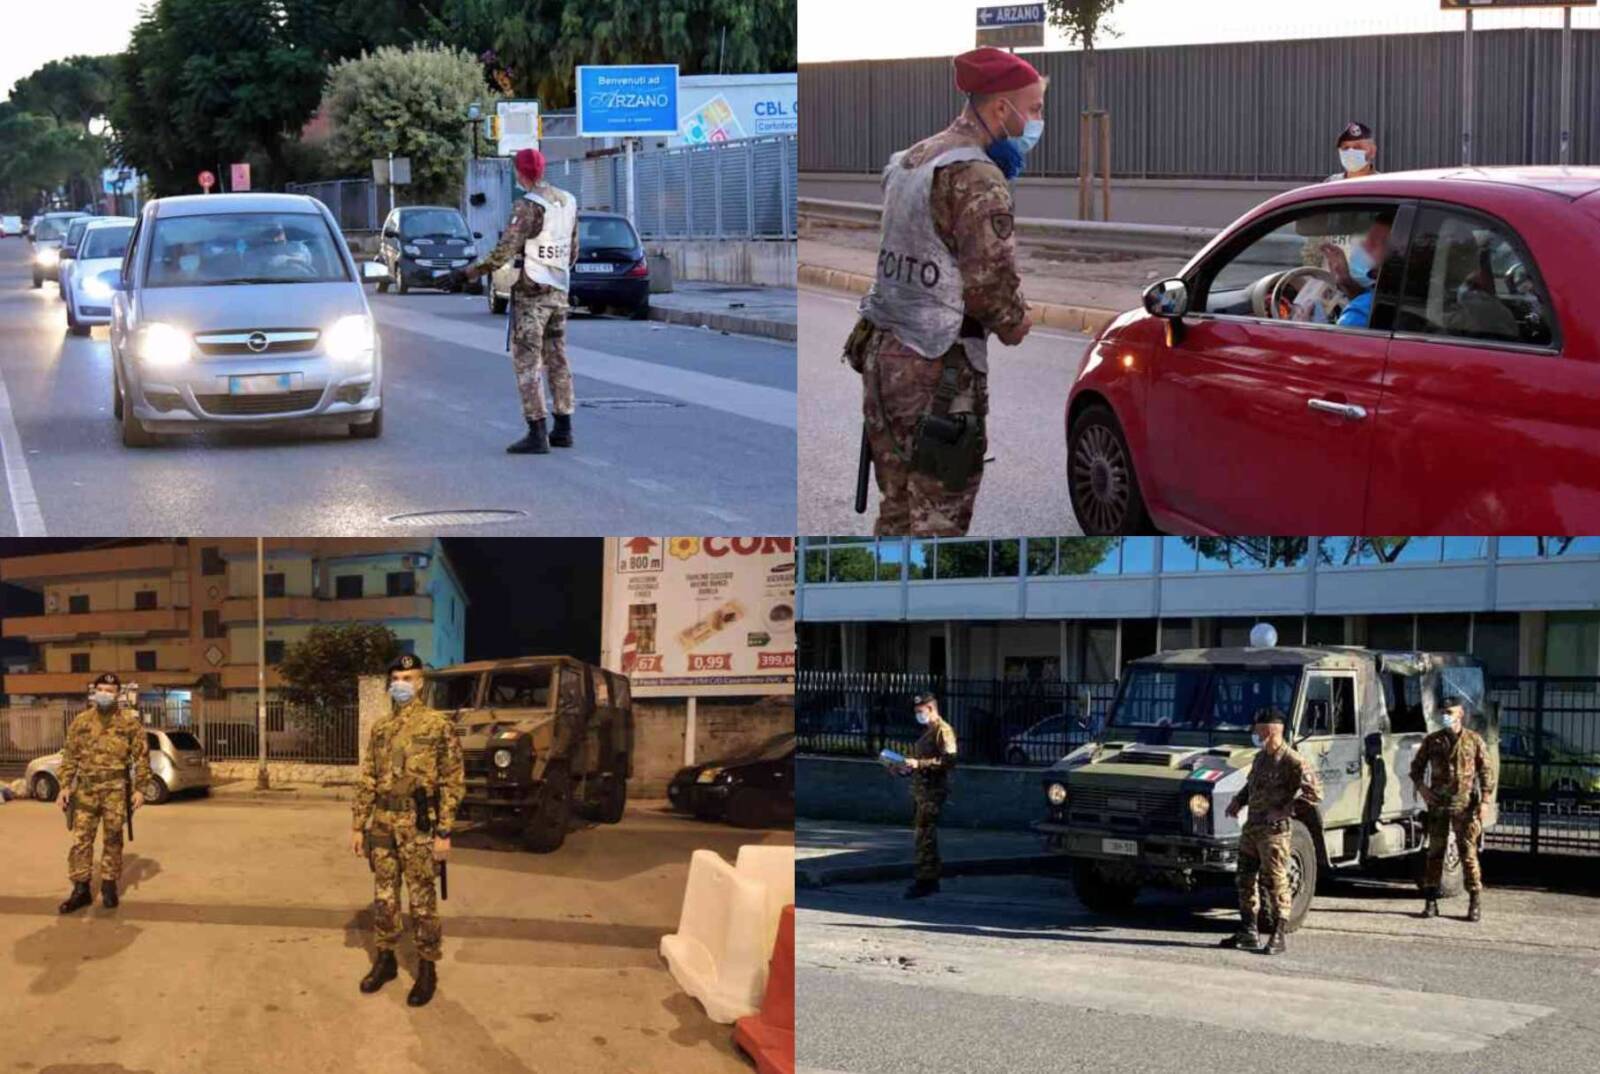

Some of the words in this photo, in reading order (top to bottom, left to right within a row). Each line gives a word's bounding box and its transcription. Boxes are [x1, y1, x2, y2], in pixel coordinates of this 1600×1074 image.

[996, 6, 1040, 21] ARZANO
[598, 76, 646, 86] Benvenuti
[647, 76, 660, 84] ad
[754, 101, 787, 116] CBL
[880, 249, 940, 289] CITO
[620, 560, 627, 570] a
[630, 556, 648, 569] 800
[651, 559, 661, 568] m
[694, 656, 724, 670] 0,99
